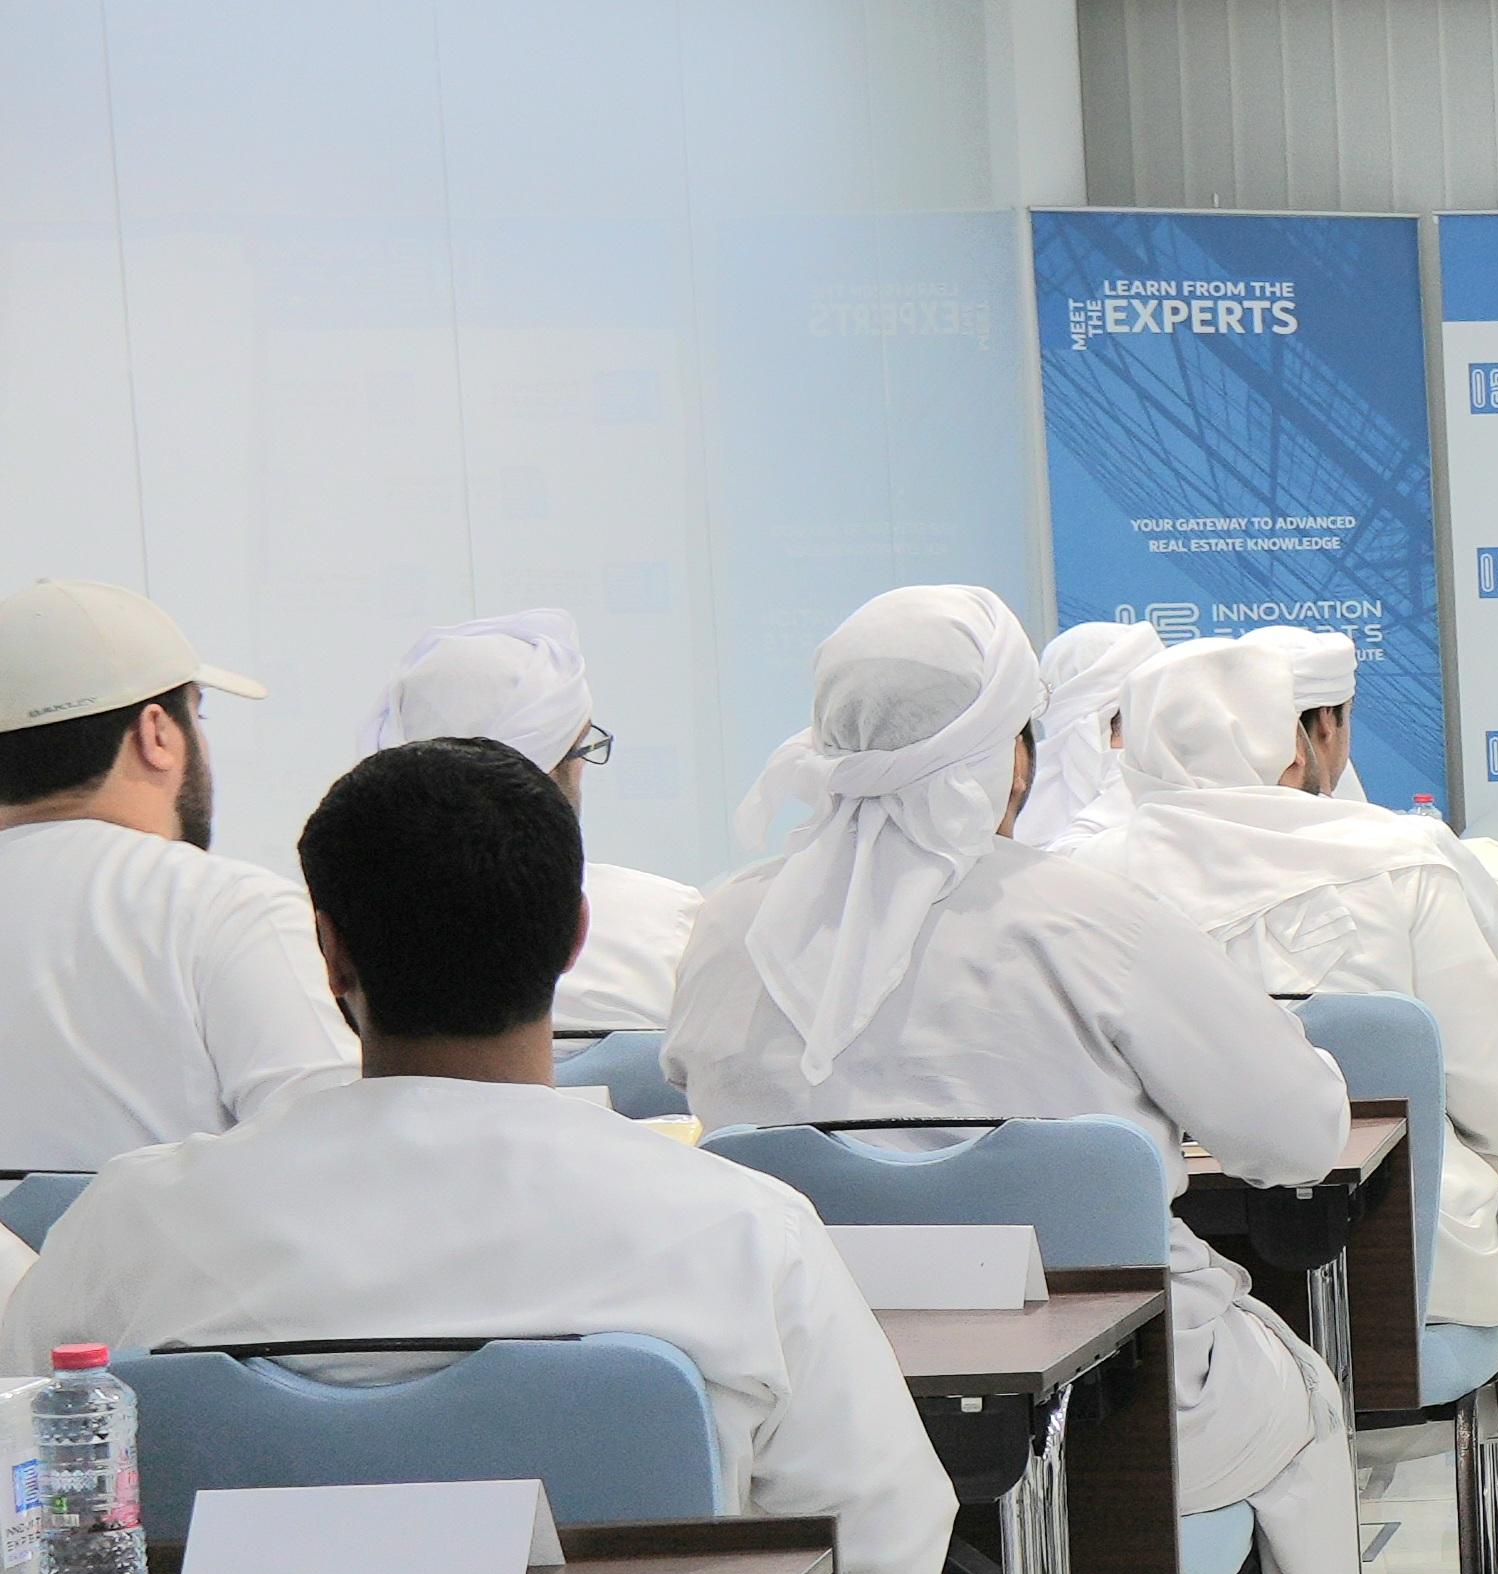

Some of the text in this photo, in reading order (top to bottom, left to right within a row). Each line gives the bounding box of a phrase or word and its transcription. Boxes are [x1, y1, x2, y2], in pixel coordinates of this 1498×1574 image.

[1104, 280, 1295, 297] LEARN FROM THE
[1069, 298, 1087, 351] MEET
[1087, 299, 1103, 337] THE
[1105, 299, 1298, 334] EXPERTS
[1131, 516, 1356, 531] YOUR GATEWAY TO ADVANCED
[1150, 537, 1341, 552] REAL ESTATE KNOWLEDGE
[1212, 600, 1382, 621] INNOVATION
